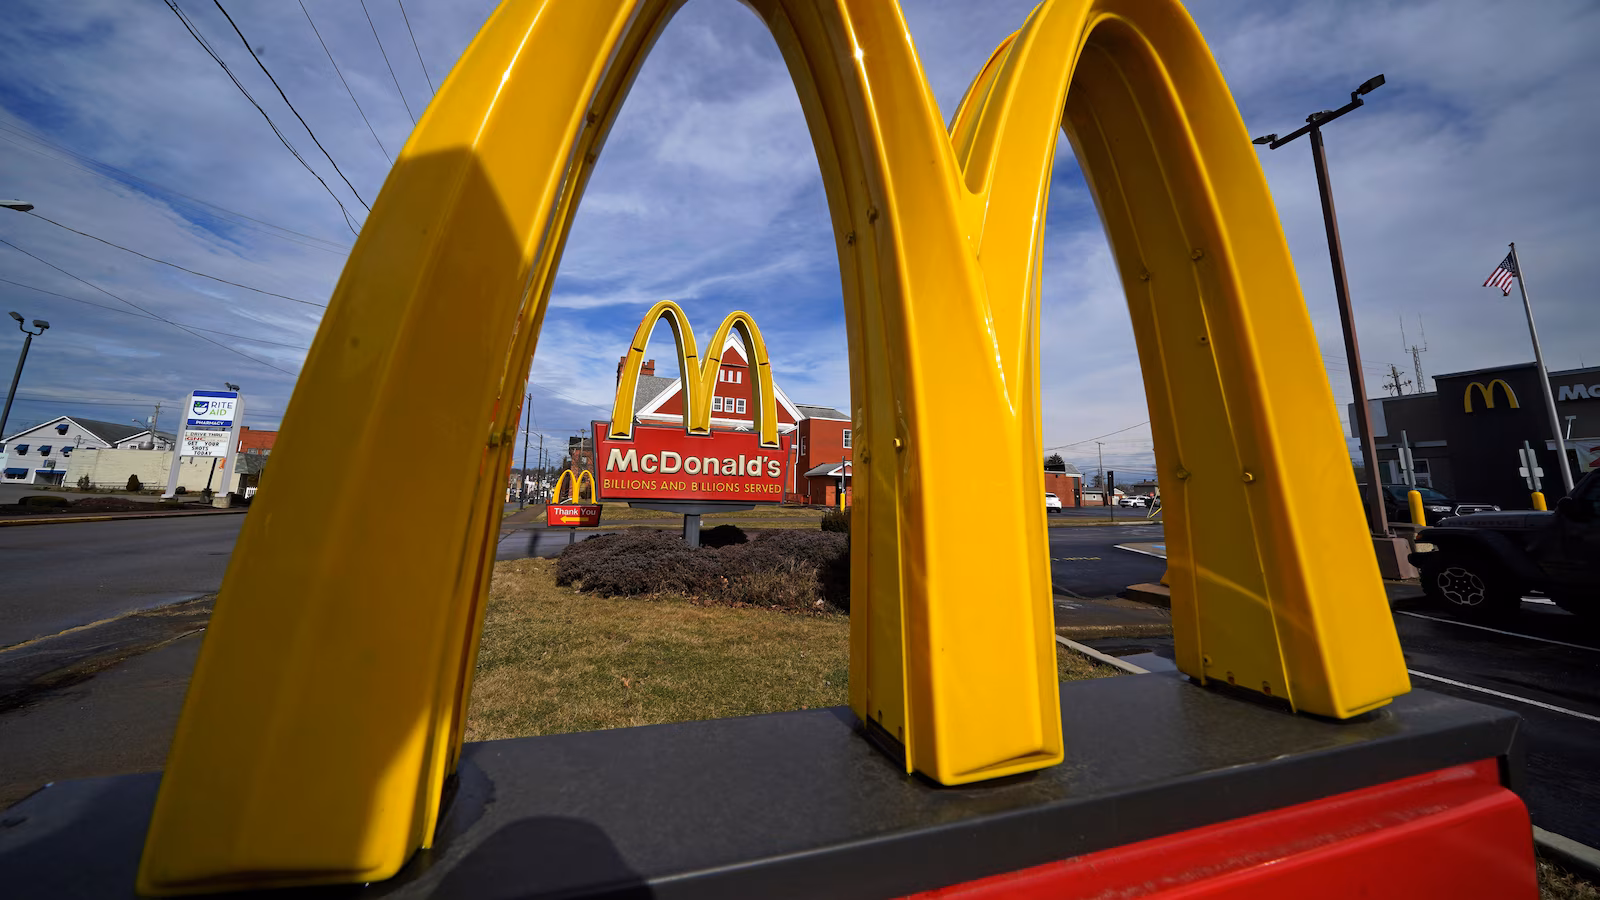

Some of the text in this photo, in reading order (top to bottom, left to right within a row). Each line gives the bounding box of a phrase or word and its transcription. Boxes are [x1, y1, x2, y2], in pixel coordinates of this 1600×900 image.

[211, 401, 233, 409] RITE
[605, 448, 782, 478] McDonald's
[603, 478, 657, 491] BILLIONS
[660, 481, 687, 492] AND
[744, 483, 782, 494] SERVED
[554, 507, 597, 516] Thank You
